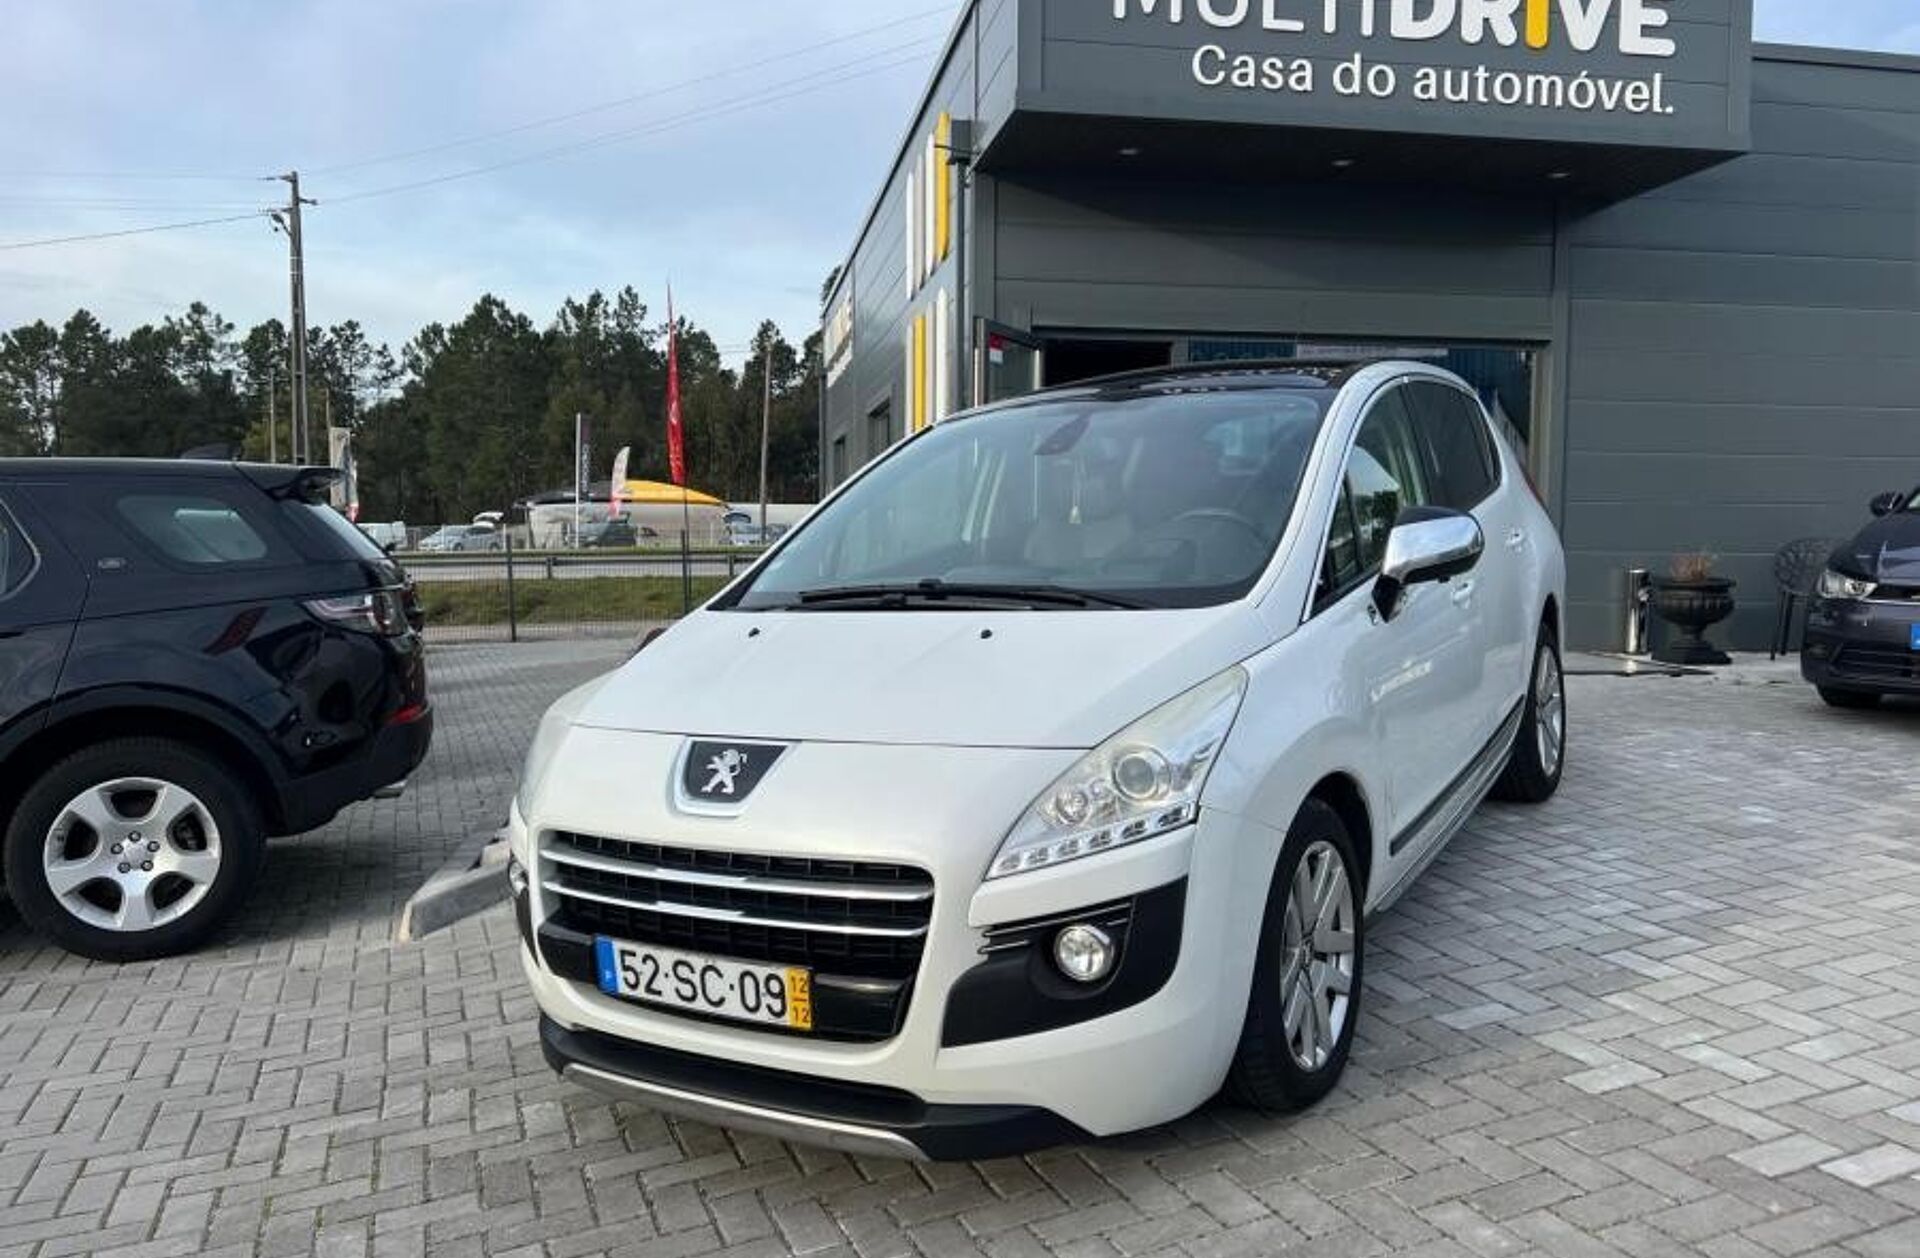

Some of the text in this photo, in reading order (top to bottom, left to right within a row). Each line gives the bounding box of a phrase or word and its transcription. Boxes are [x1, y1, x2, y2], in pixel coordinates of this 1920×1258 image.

[1192, 44, 1674, 114] Casa do automóvel.
[791, 976, 808, 994] 12
[793, 1005, 810, 1024] 12
